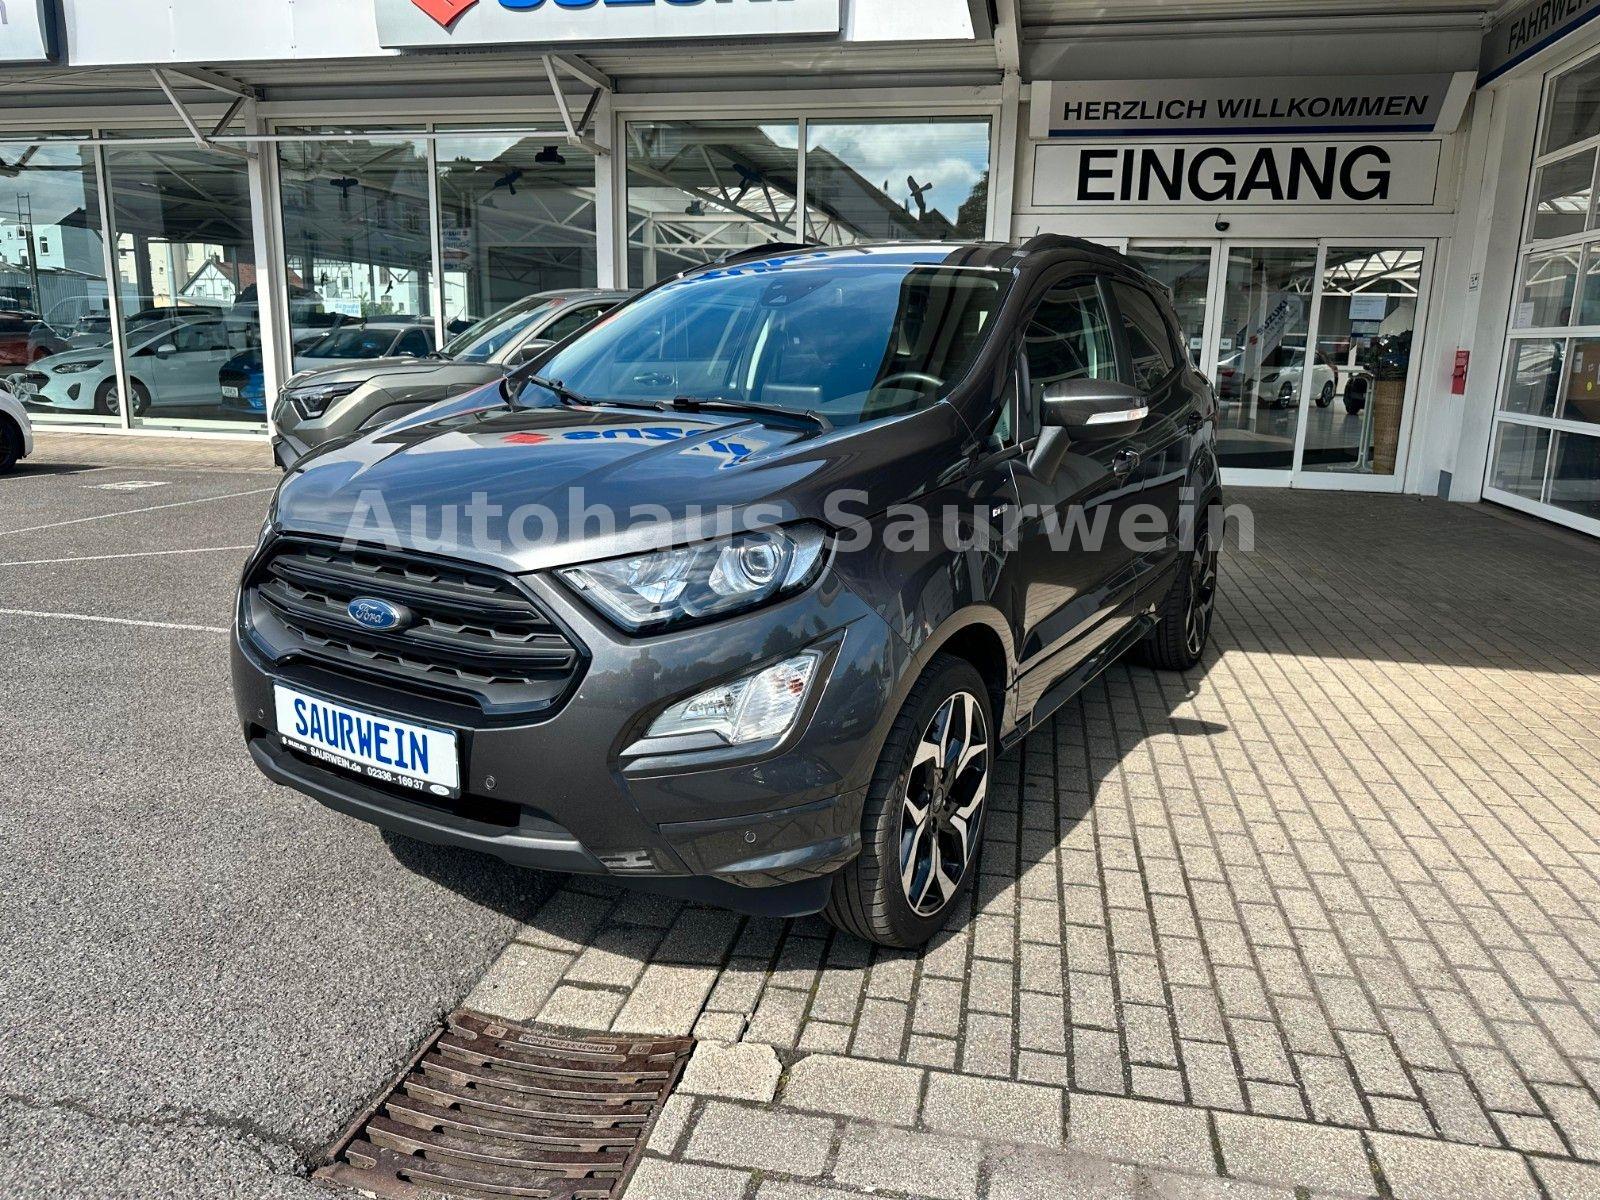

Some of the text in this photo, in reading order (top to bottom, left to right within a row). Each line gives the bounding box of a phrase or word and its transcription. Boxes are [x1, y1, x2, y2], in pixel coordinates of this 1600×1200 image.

[1508, 0, 1590, 54] FAHRW
[1063, 95, 1429, 121] HERZLICH WILLKOMMEN
[1076, 145, 1392, 202] EINGANG
[294, 698, 429, 774] SAURWEIN
[310, 746, 362, 773] SAURWEIN.de
